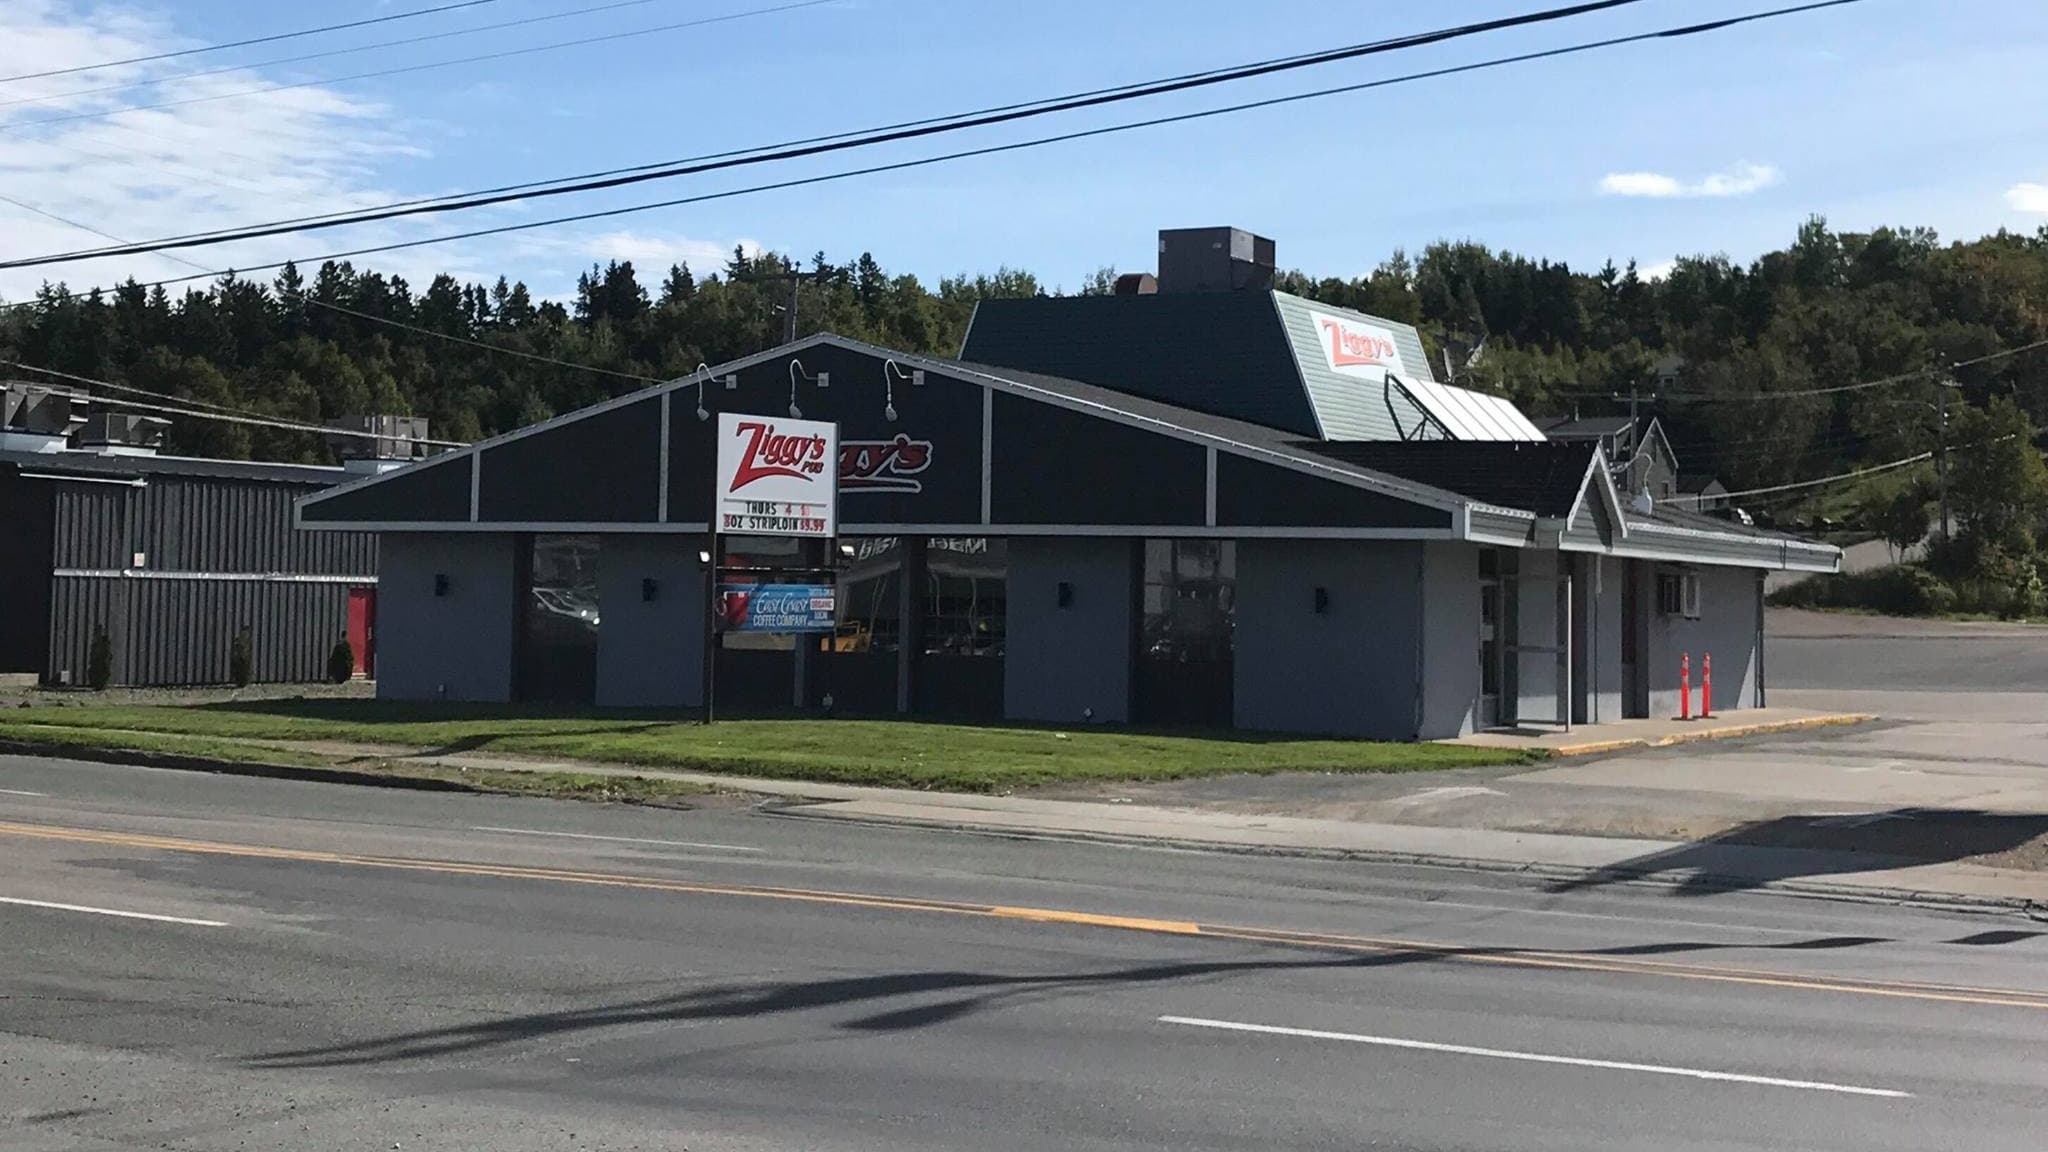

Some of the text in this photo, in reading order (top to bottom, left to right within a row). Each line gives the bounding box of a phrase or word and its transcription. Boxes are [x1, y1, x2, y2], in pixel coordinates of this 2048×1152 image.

[1321, 319, 1394, 366] Ziggy's
[730, 422, 826, 492] Ziggy's
[801, 461, 824, 474] PUB
[745, 501, 777, 515] THURS
[749, 517, 799, 531] STRIPLOIN
[753, 614, 777, 626] COFFEE
[777, 614, 808, 627] COMPANY
